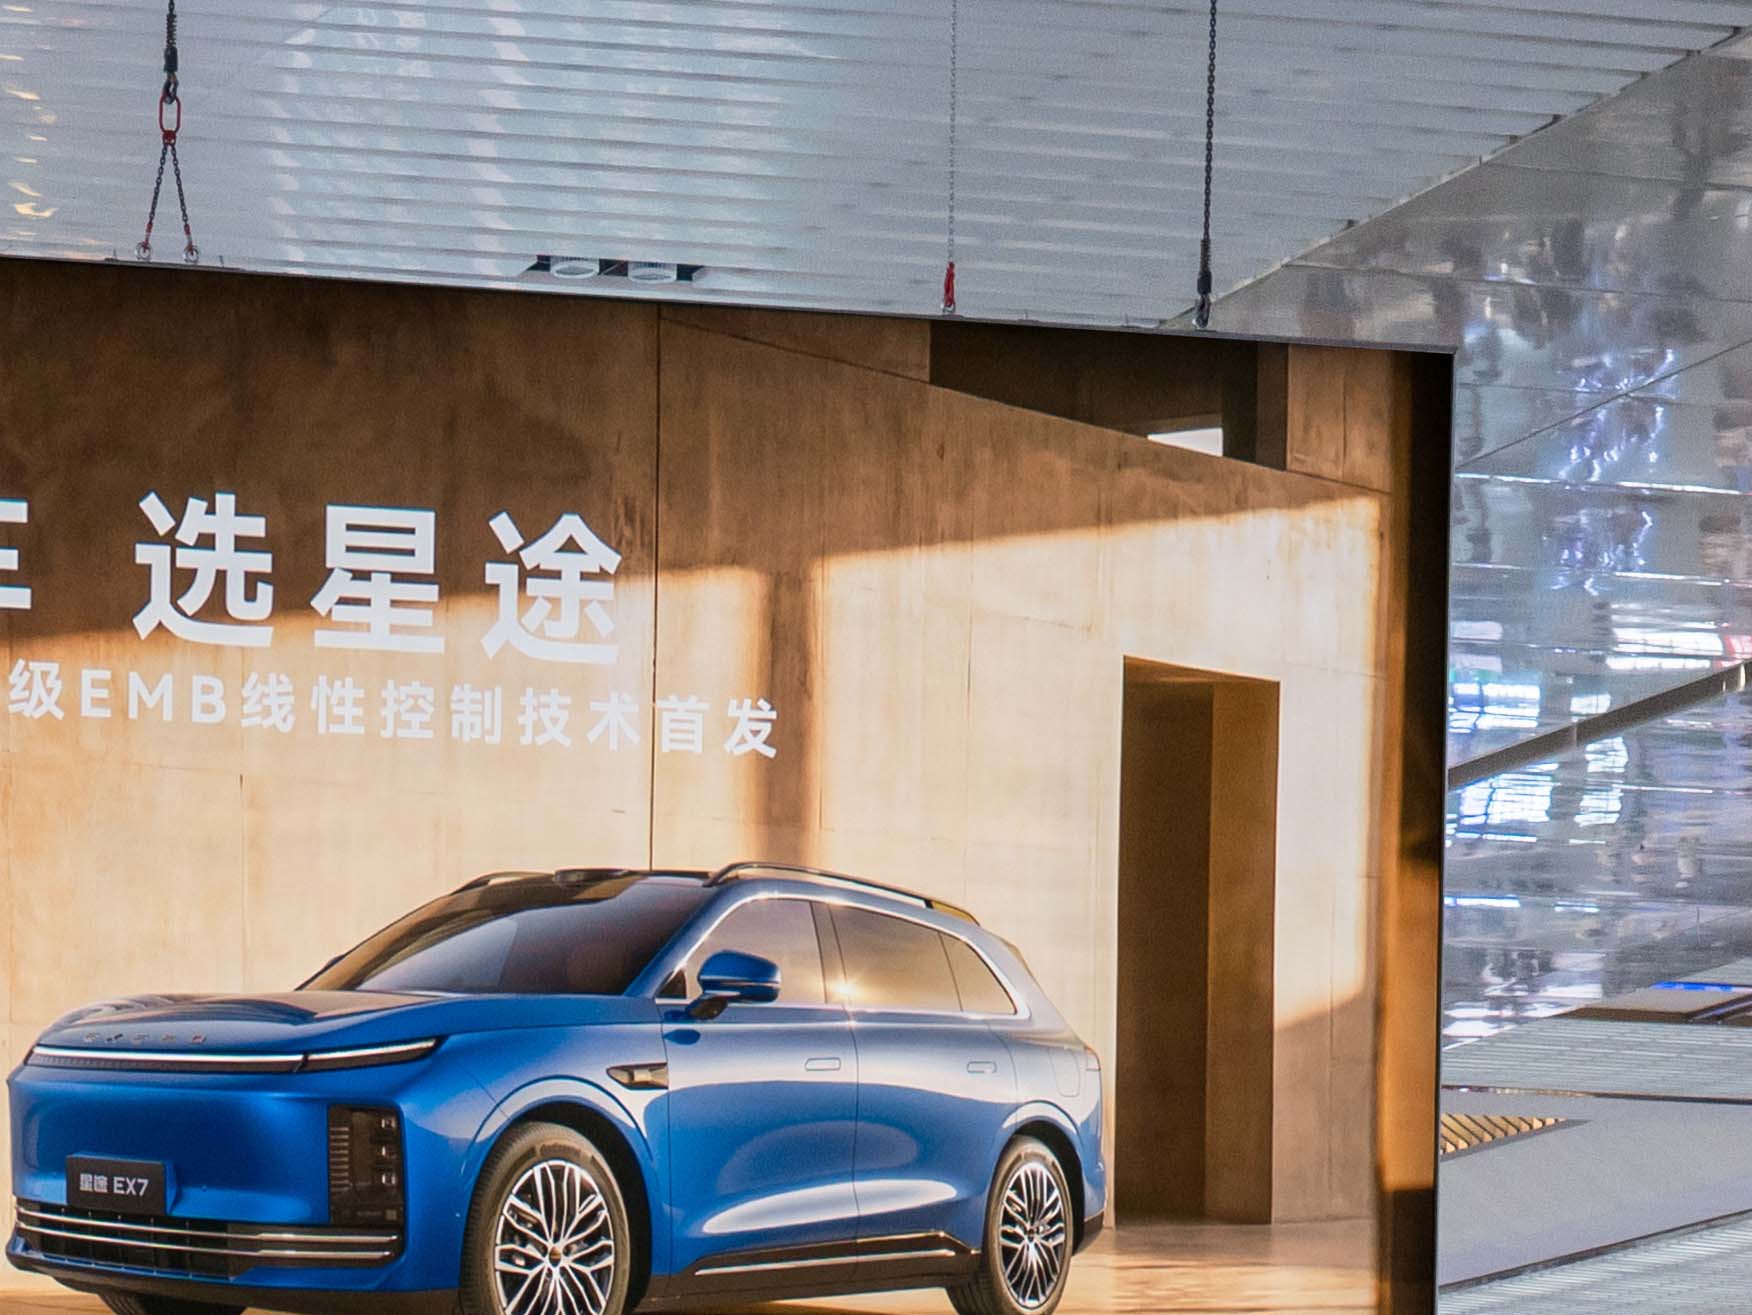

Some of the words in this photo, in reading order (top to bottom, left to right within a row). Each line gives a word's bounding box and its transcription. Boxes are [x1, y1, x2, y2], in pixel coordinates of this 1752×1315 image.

[132, 490, 623, 667] 选星途
[113, 1177, 149, 1197] EX7
